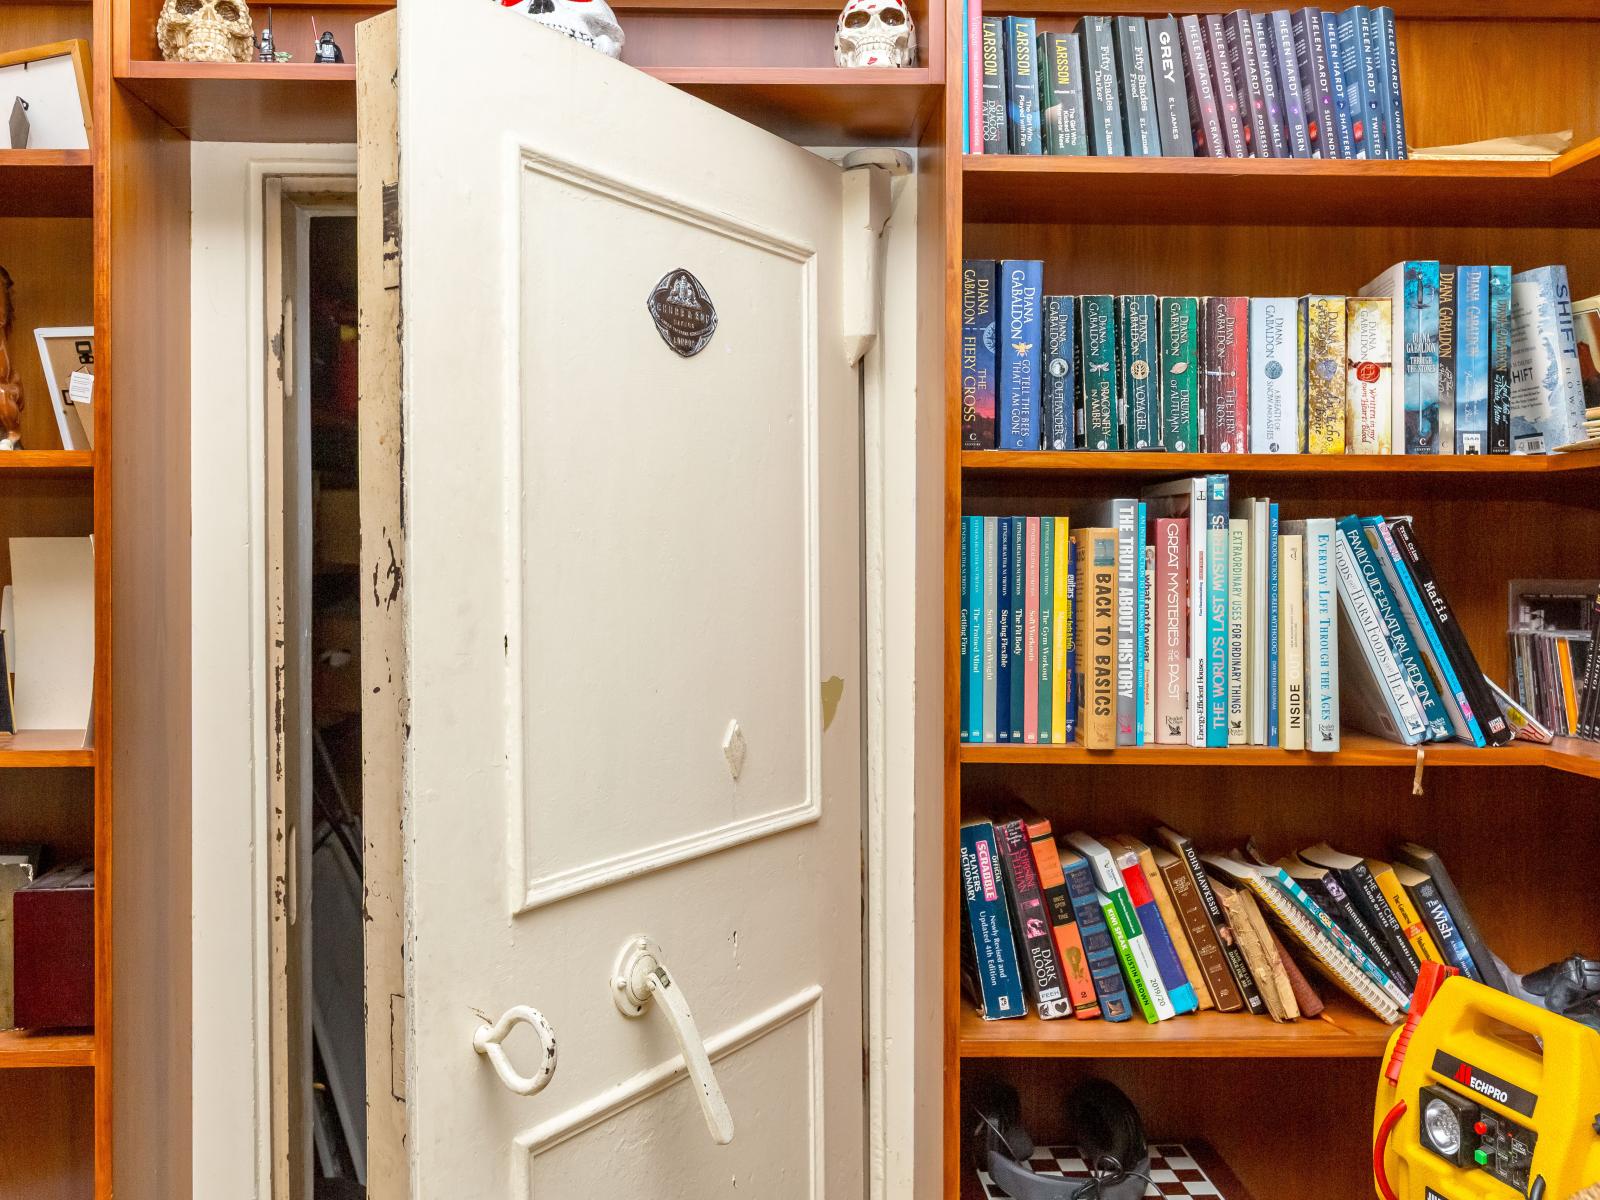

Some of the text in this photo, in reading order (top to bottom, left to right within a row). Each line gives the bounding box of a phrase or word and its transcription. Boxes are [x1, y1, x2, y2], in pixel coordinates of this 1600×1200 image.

[983, 23, 997, 75] LARSSON
[1016, 24, 1030, 76] LARSSON
[1056, 39, 1069, 84] LARSSON
[1159, 32, 1175, 83] GREY
[1189, 25, 1211, 100] HELEN HARDT
[1214, 24, 1233, 98] HELEN HARDT
[1242, 19, 1260, 95] HELEN HARDT
[1256, 22, 1274, 98] HELEN HARDT
[1280, 20, 1298, 97] HELEN HARDT
[1312, 16, 1322, 51] HELEN
[1317, 56, 1328, 92] HARDT
[1328, 23, 1344, 98] HELEN HARDT
[1362, 18, 1376, 94] HELEN HARDT
[1094, 70, 1103, 101] Darker
[1100, 46, 1114, 111] Fifty Shades
[1134, 46, 1148, 111] Fifty Shades
[1391, 59, 1399, 96] HARDT
[989, 100, 997, 141] DRAGON
[996, 105, 1004, 128] GIRL
[1170, 112, 1179, 139] JAMES
[1272, 124, 1282, 148] MELT
[1295, 125, 1304, 151] BURN
[1372, 117, 1380, 155] TWISTED
[964, 270, 975, 324] GABALDON
[978, 279, 989, 314] DIANA
[1011, 270, 1024, 338] GABALDON
[1024, 287, 1035, 323] DIANA
[1439, 272, 1454, 357] DIANA GABALDON
[1556, 284, 1576, 358] SHIFT
[1049, 301, 1060, 355] GABALDON
[1059, 314, 1067, 342] DIANA
[1089, 303, 1099, 355] GABALDON
[1098, 316, 1107, 343] DIANA
[1130, 302, 1140, 355] GABALDON
[1139, 315, 1148, 343] DIANA
[1170, 303, 1181, 355] GABALDON
[1180, 316, 1188, 343] DIANA
[1360, 311, 1369, 361] GABALDON
[1368, 321, 1376, 350] DIANA
[964, 337, 975, 421] FIERY CROSS
[978, 369, 986, 389] THE
[1012, 361, 1021, 435] THAT AM GONE
[1021, 360, 1030, 436] GO TELL THE BEES
[1226, 388, 1235, 406] THE
[1054, 381, 1064, 435] OUTLANDER
[1092, 397, 1101, 429] AMBER
[1100, 381, 1110, 435] DRAGONFLY
[1136, 385, 1146, 431] VOYAGER
[1170, 389, 1180, 432] AUTUMN
[1180, 390, 1189, 424] DRUMS
[1216, 396, 1226, 426] CROSS
[1067, 574, 1075, 598] guitars
[1118, 506, 1134, 698] THE TRUTH ABOUT HISTORY
[1167, 523, 1179, 700] GREAT MYSTERIES PAST
[1423, 580, 1449, 623] Mafia
[1000, 609, 1008, 637] Staying
[1040, 626, 1048, 644] Gym
[1094, 573, 1112, 716] BACK TO BASICS
[1212, 515, 1225, 729] THE WORLD'S LAST MYSTERIES
[1231, 531, 1242, 714] EXTRAORDINARY USES FOR ORDINARY THINGS
[1318, 534, 1332, 720] EVERYDAY LIFE THROUGH THE AGES
[1336, 542, 1408, 710] FOODS HARM FOODS HEAL
[1347, 529, 1368, 564] FAMILY
[1364, 562, 1383, 597] GUIDE
[1382, 603, 1406, 655] NATURAL
[1404, 653, 1435, 710] MEDICINE
[1014, 637, 1022, 655] Body
[1196, 678, 1204, 741] Energy-Efficient
[1290, 684, 1301, 729] INSIDE
[961, 847, 976, 902] DICTIONARY
[969, 854, 983, 893] PLAYERS
[977, 842, 995, 899] SCRABBLE
[1186, 847, 1200, 871] JOHN
[1195, 869, 1221, 916] HAWKESBY
[1363, 885, 1375, 905] BLOOD
[990, 915, 998, 937] Newly
[1365, 875, 1400, 932] THE WITCHER
[1426, 899, 1439, 907] The
[1432, 905, 1453, 939] Wish
[979, 911, 989, 945] Updated
[988, 958, 997, 986] Edition
[993, 937, 1003, 964] Revised
[1031, 946, 1048, 988] BLOOD
[1042, 949, 1057, 982] DARK
[1107, 907, 1119, 930] KIWI
[1114, 927, 1127, 951] SPEAK
[1125, 953, 1138, 978] JUSTIN
[1135, 977, 1149, 1006] BROWN
[1150, 978, 1165, 1007] 2019/20
[1453, 1063, 1508, 1103] MECHPRO
